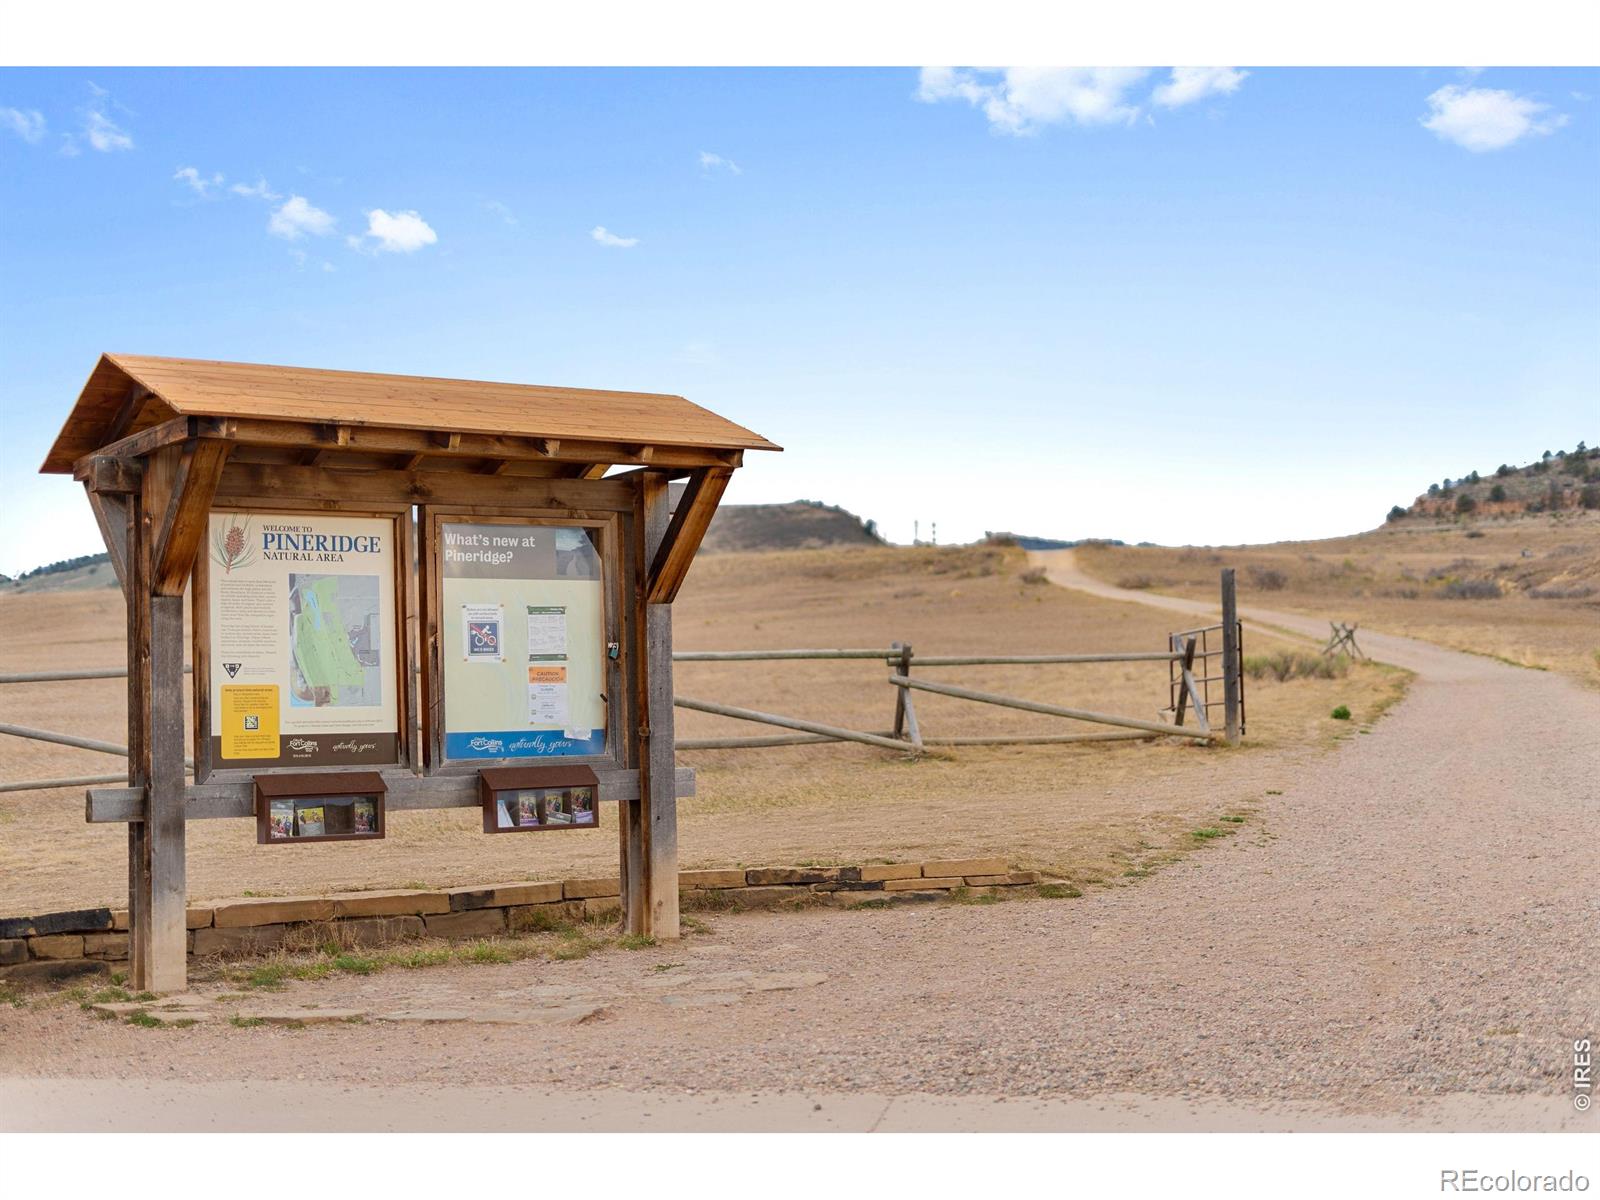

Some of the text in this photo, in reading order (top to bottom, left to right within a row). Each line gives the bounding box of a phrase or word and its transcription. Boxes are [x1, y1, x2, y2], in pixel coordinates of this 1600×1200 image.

[263, 525, 300, 533] WELCOME
[262, 533, 381, 553] PINERIDGE
[444, 532, 536, 548] What's new at
[263, 551, 344, 563] NATURAL AREA
[445, 550, 513, 565] Pineridge?
[470, 739, 483, 747] Fort
[509, 735, 572, 753] naturally yours
